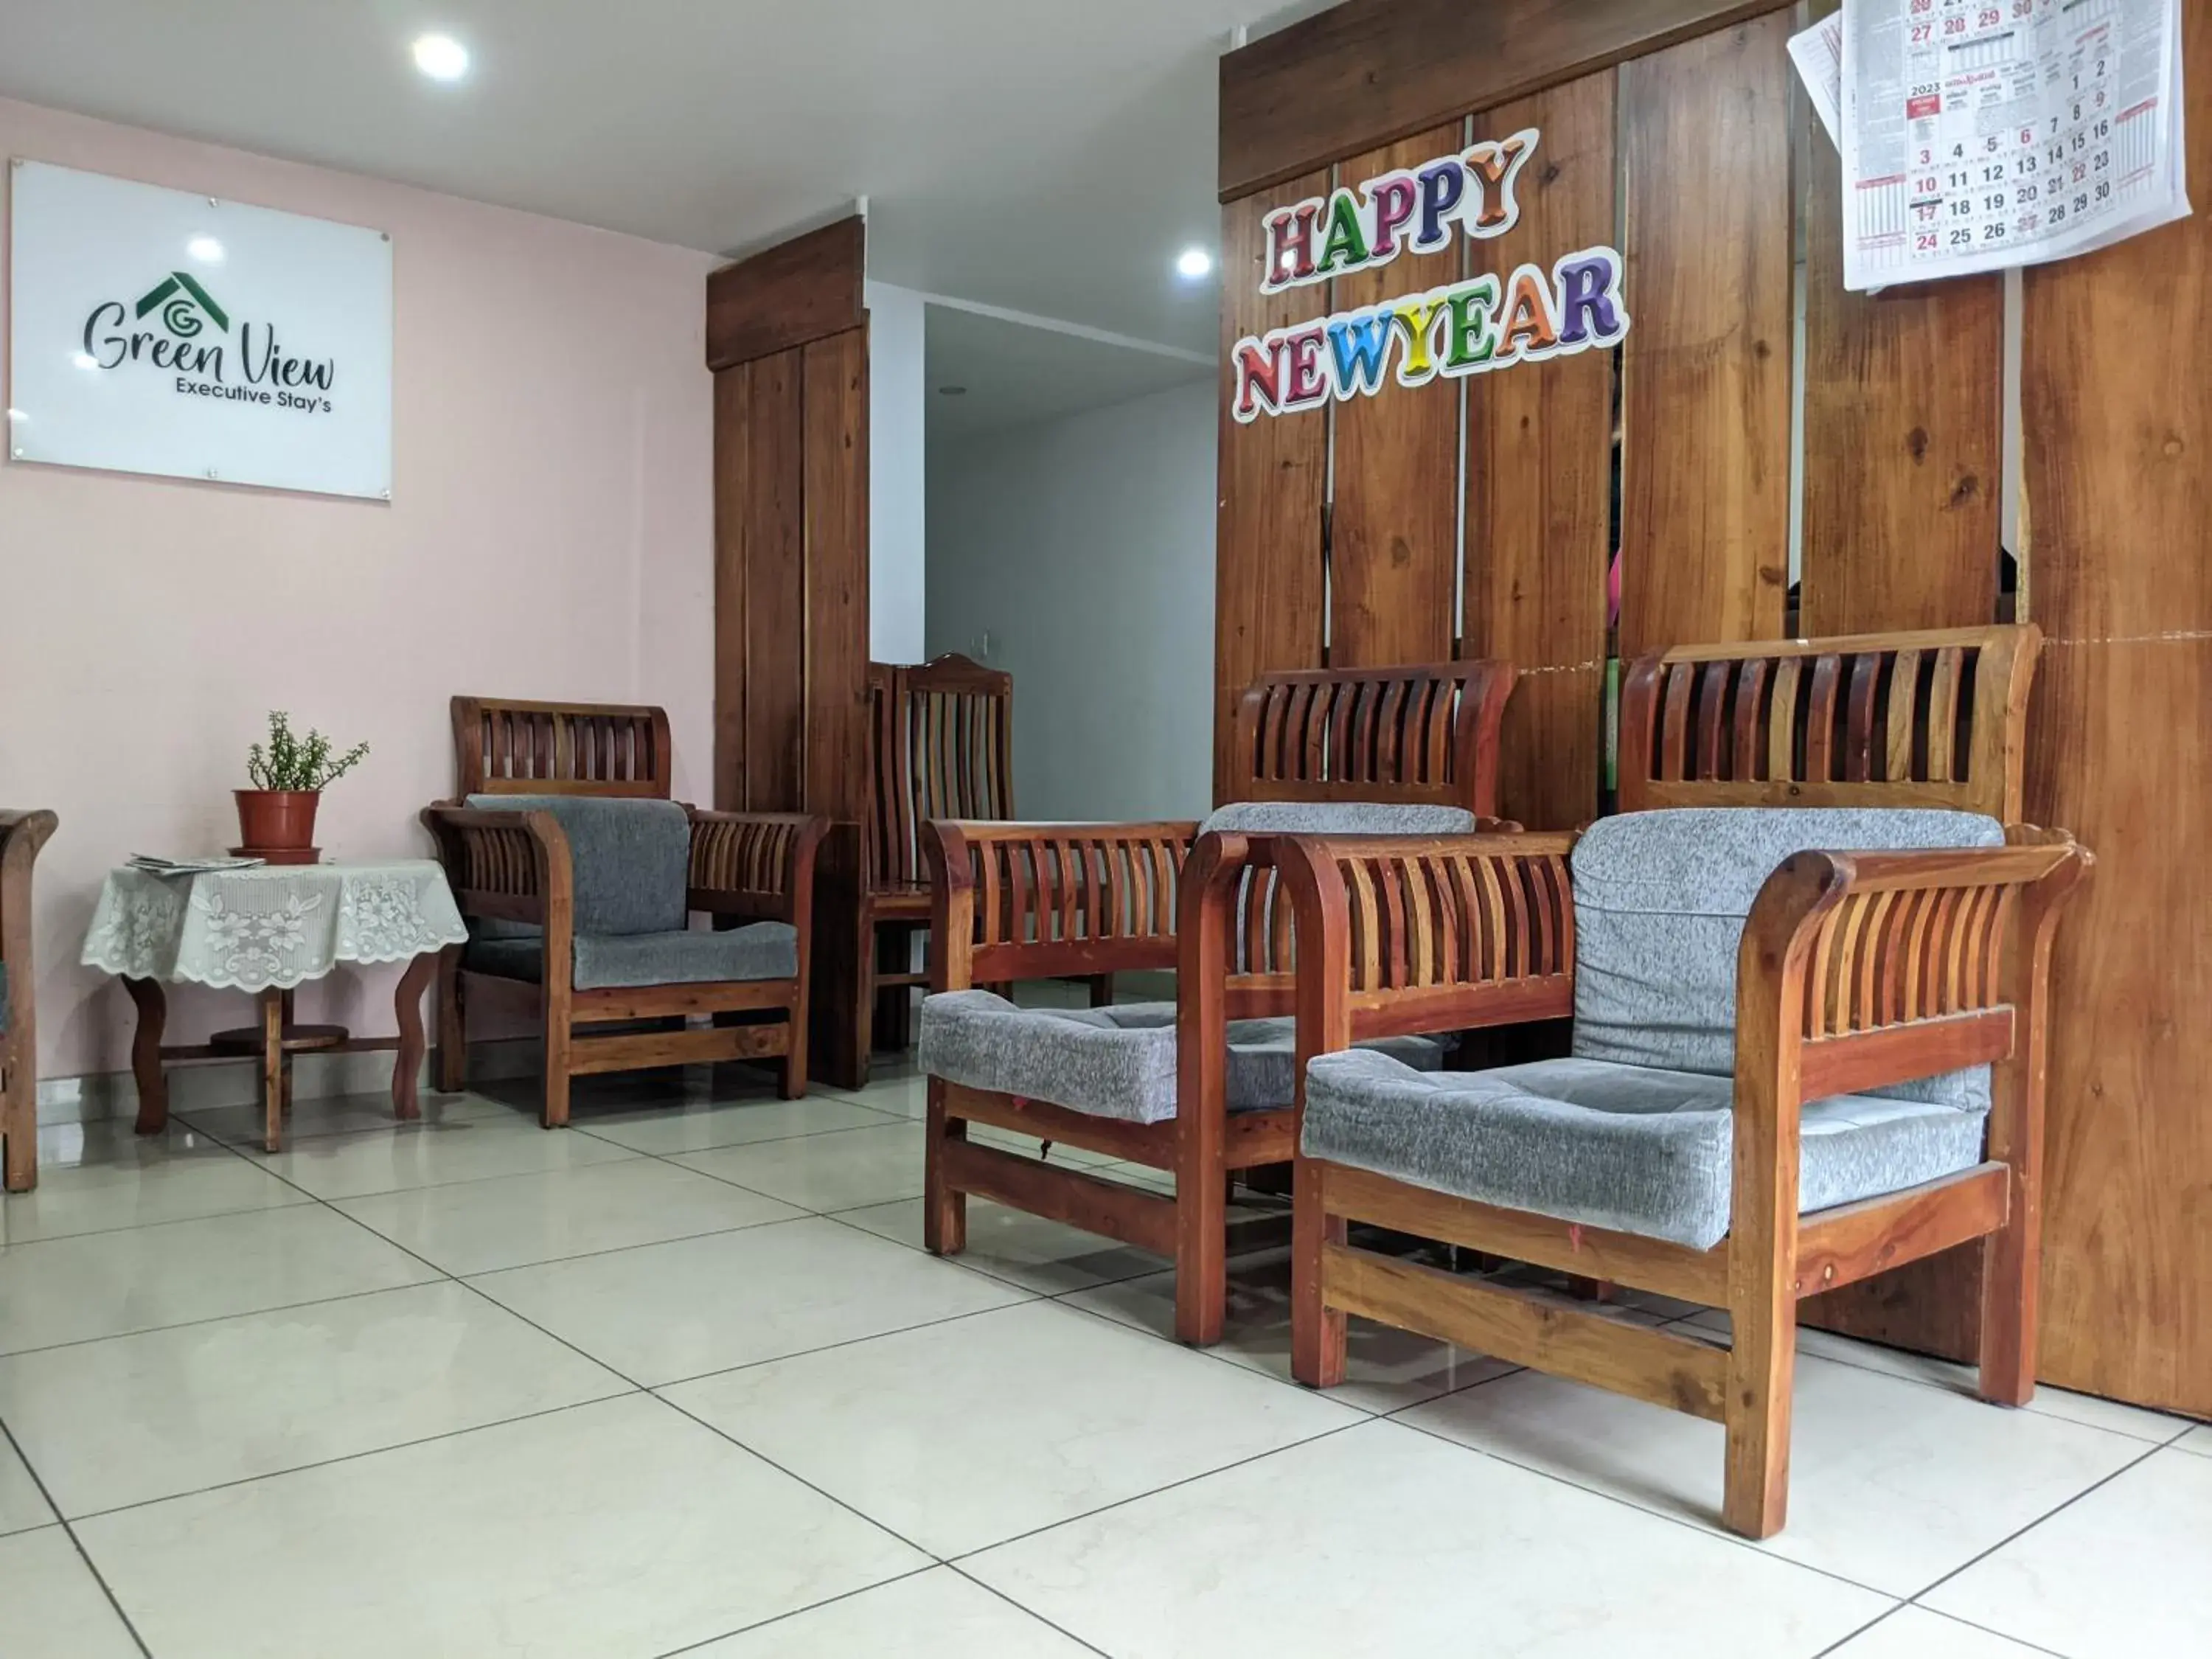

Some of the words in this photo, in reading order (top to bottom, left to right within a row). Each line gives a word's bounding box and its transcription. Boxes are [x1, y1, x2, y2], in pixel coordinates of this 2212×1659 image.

[1911, 24, 1932, 42] 27
[1978, 10, 2000, 28] 29
[1911, 82, 1941, 97] 2023
[2073, 74, 2079, 90] 1
[2096, 60, 2106, 77] 2
[1916, 176, 1937, 193] 10
[1949, 171, 1967, 187] 11
[1983, 164, 2003, 181] 12
[2017, 156, 2037, 174] 13
[2048, 145, 2063, 164] 14
[2072, 132, 2085, 152] 15
[2093, 119, 2108, 139] 16
[1919, 150, 1930, 164] 3
[1952, 143, 1964, 158] 4
[1987, 136, 1997, 152] 5
[2020, 129, 2031, 144] 6
[2050, 116, 2058, 133] 7
[2073, 104, 2080, 121] 8
[2096, 91, 2105, 108] 9
[1268, 139, 1525, 288] HAPPY
[1916, 205, 1937, 222] 17
[1950, 200, 1970, 216] 18
[1983, 193, 2004, 211] 19
[2017, 185, 2037, 204] 20
[2048, 175, 2063, 195] 21
[2094, 150, 2109, 172] 23
[1917, 234, 1937, 251] 24
[1950, 228, 1971, 246] 25
[1983, 222, 2006, 240] 26
[2048, 204, 2065, 224] 28
[2073, 192, 2087, 213] 29
[2095, 181, 2110, 201] 30
[83, 301, 223, 383] Green
[241, 321, 335, 391] View
[176, 377, 272, 405] Executive
[276, 391, 333, 414] Stay's
